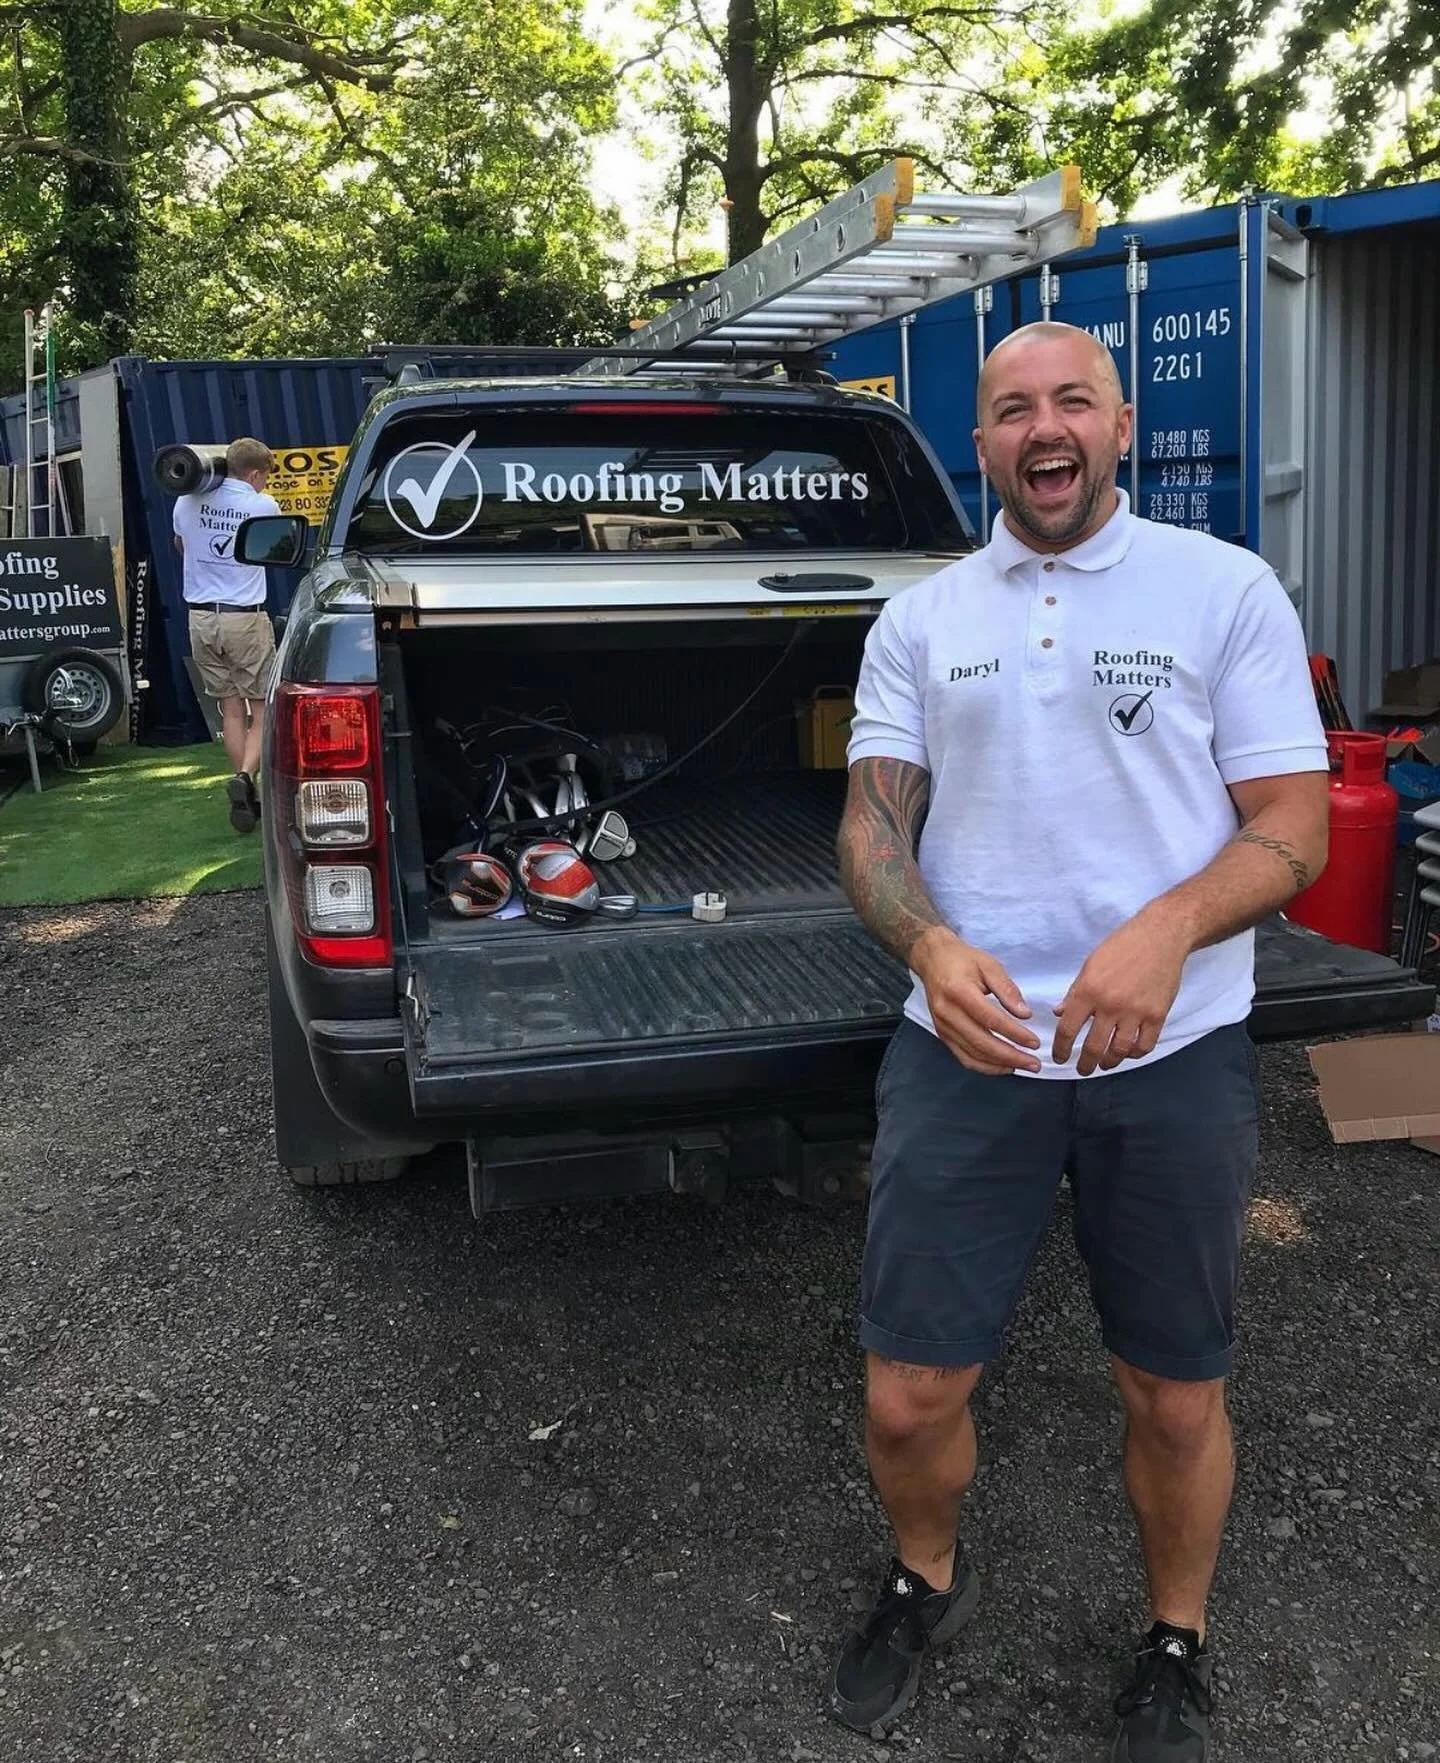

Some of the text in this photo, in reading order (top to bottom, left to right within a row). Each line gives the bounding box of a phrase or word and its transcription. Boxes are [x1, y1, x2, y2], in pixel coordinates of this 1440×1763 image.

[1085, 308, 1231, 348] ANU 600145
[1152, 352, 1202, 382] 22G1
[1151, 429, 1210, 445] 30.480 KGS
[1151, 443, 1209, 459] 67.200 LBS
[501, 462, 869, 513] Roofing Matters
[1194, 474, 1212, 486] LBS
[295, 497, 312, 511] 80
[1150, 492, 1208, 507] 28.330 KGS
[200, 504, 251, 521] Roofing
[1150, 506, 1208, 520] 62.460 LBS
[0, 584, 107, 616] Supplies
[1093, 650, 1175, 671] Roofing
[949, 658, 1000, 682] Daryl
[1092, 669, 1172, 688] Matters
